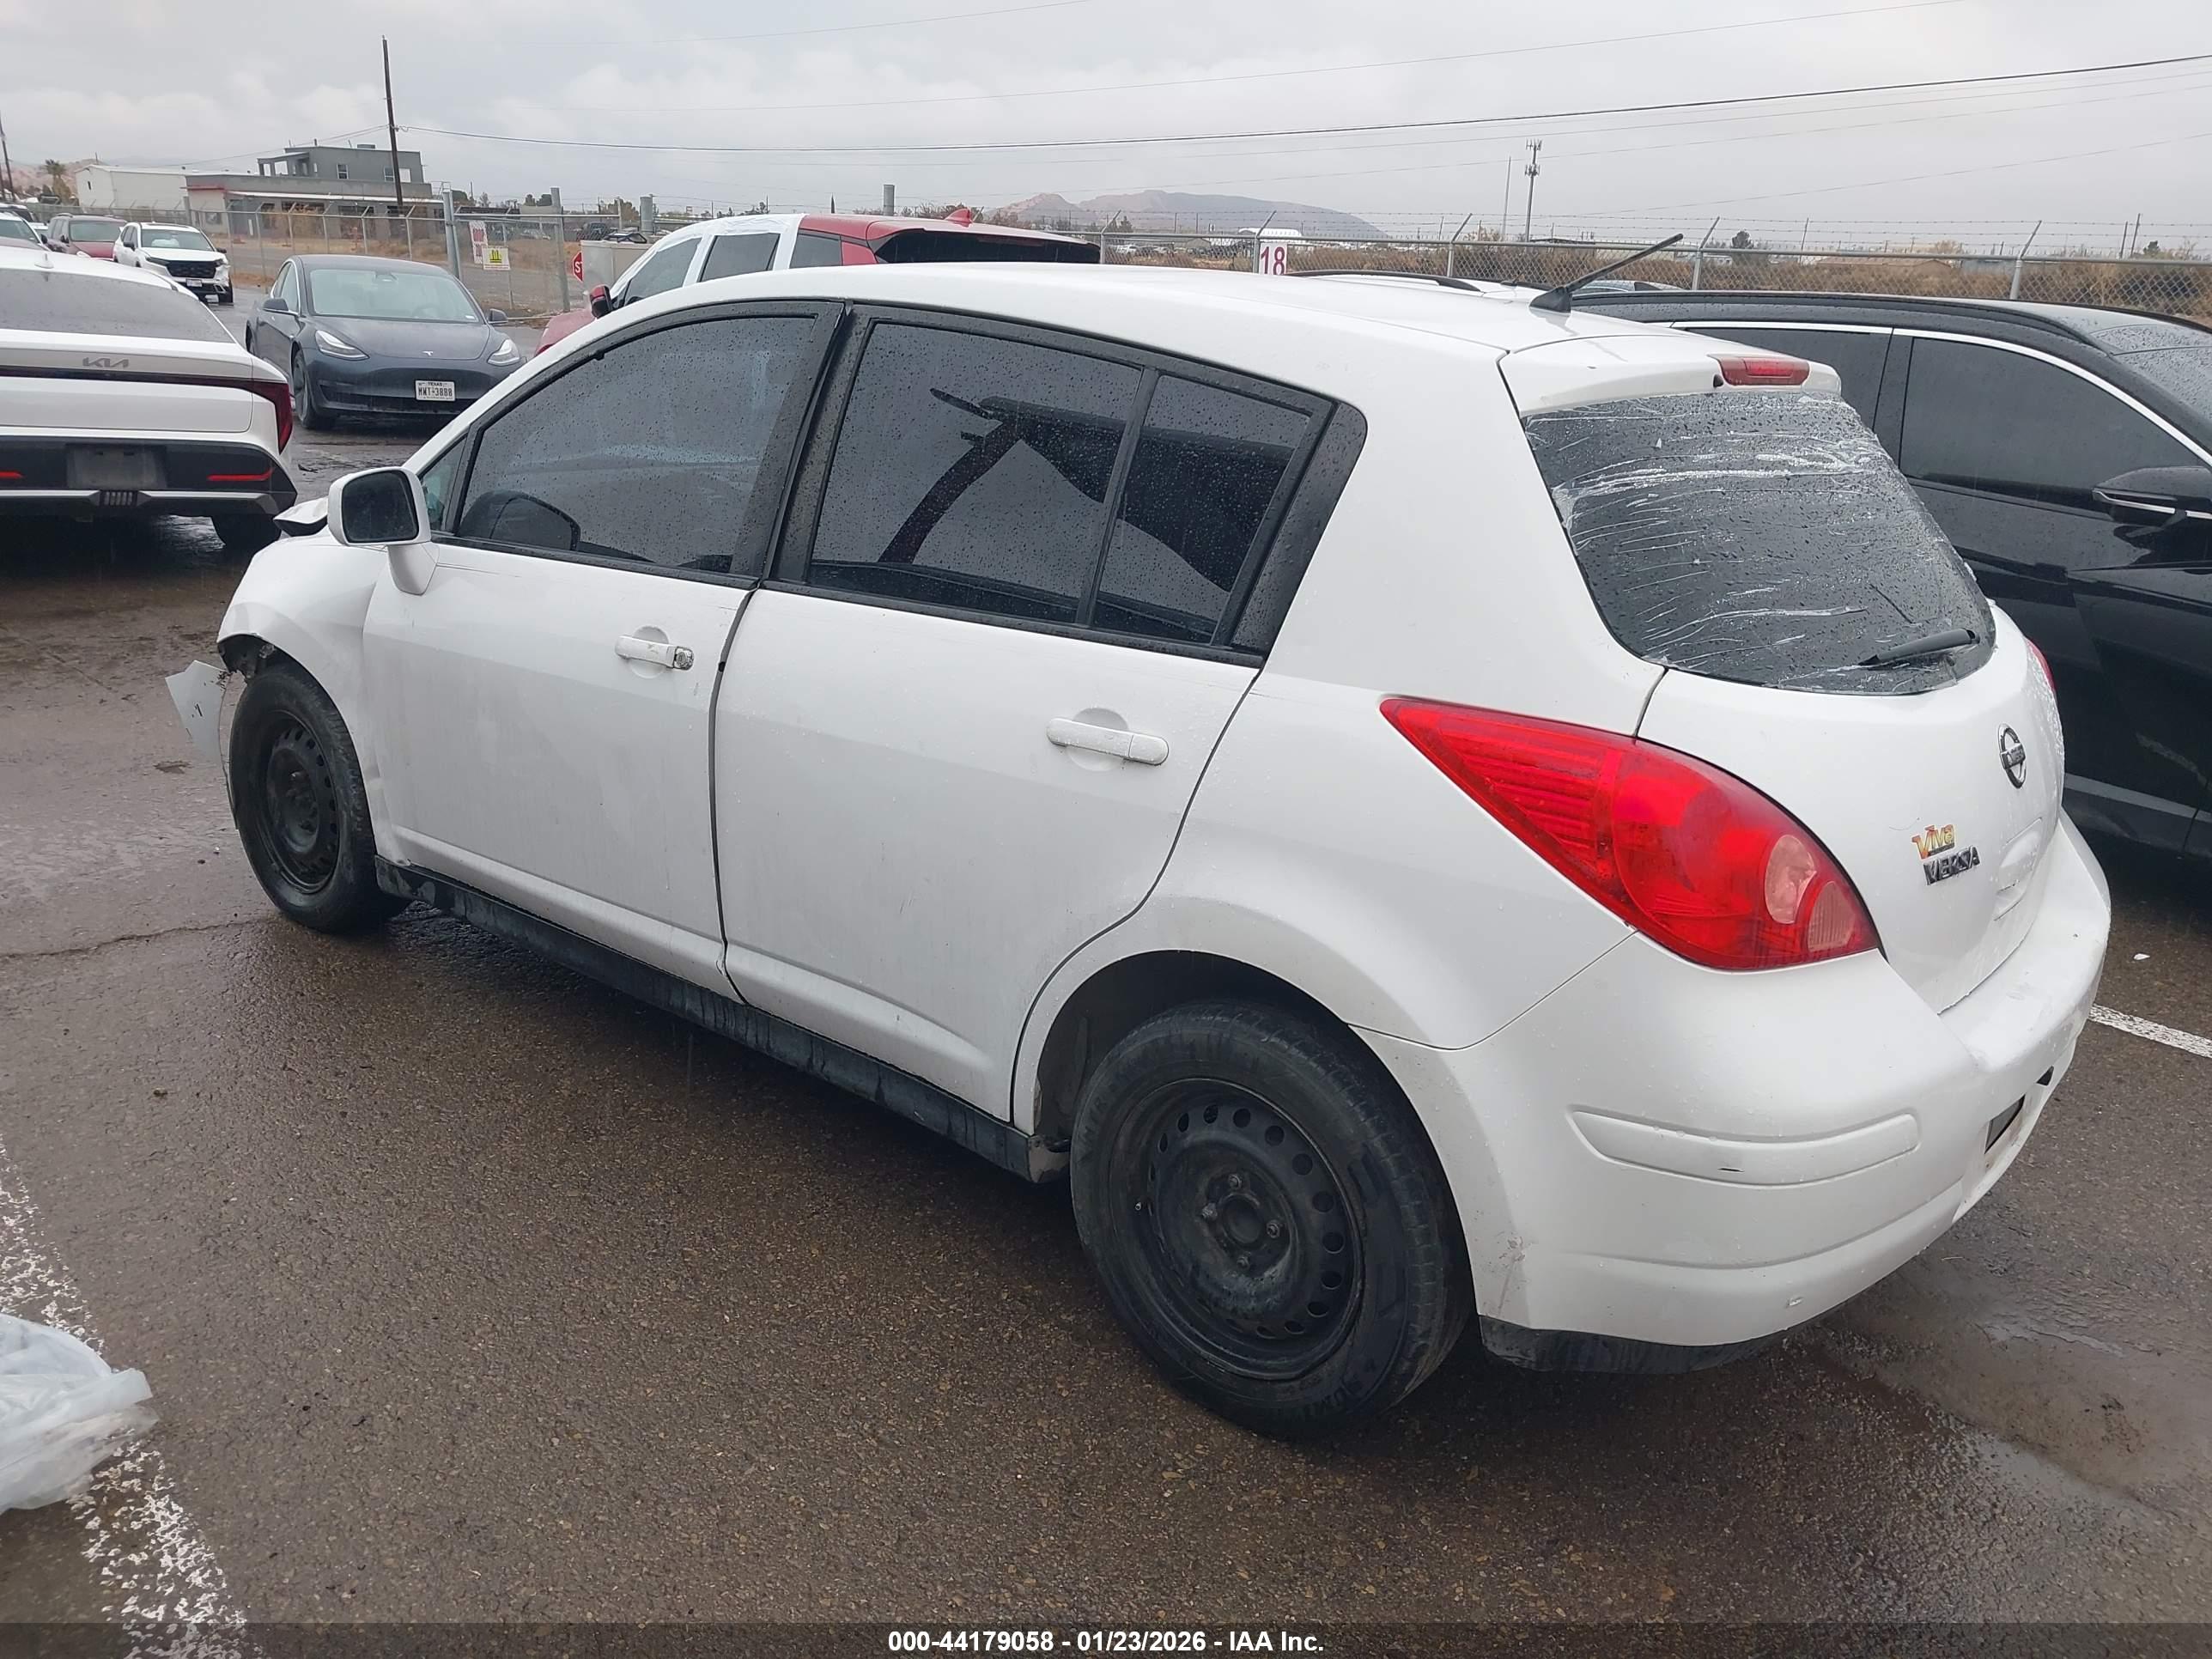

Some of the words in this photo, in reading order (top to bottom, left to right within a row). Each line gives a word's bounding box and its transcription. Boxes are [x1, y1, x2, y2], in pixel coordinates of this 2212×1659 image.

[1261, 246, 1285, 275] 18
[82, 357, 129, 368] KIA
[1923, 846, 1980, 885] VERSA
